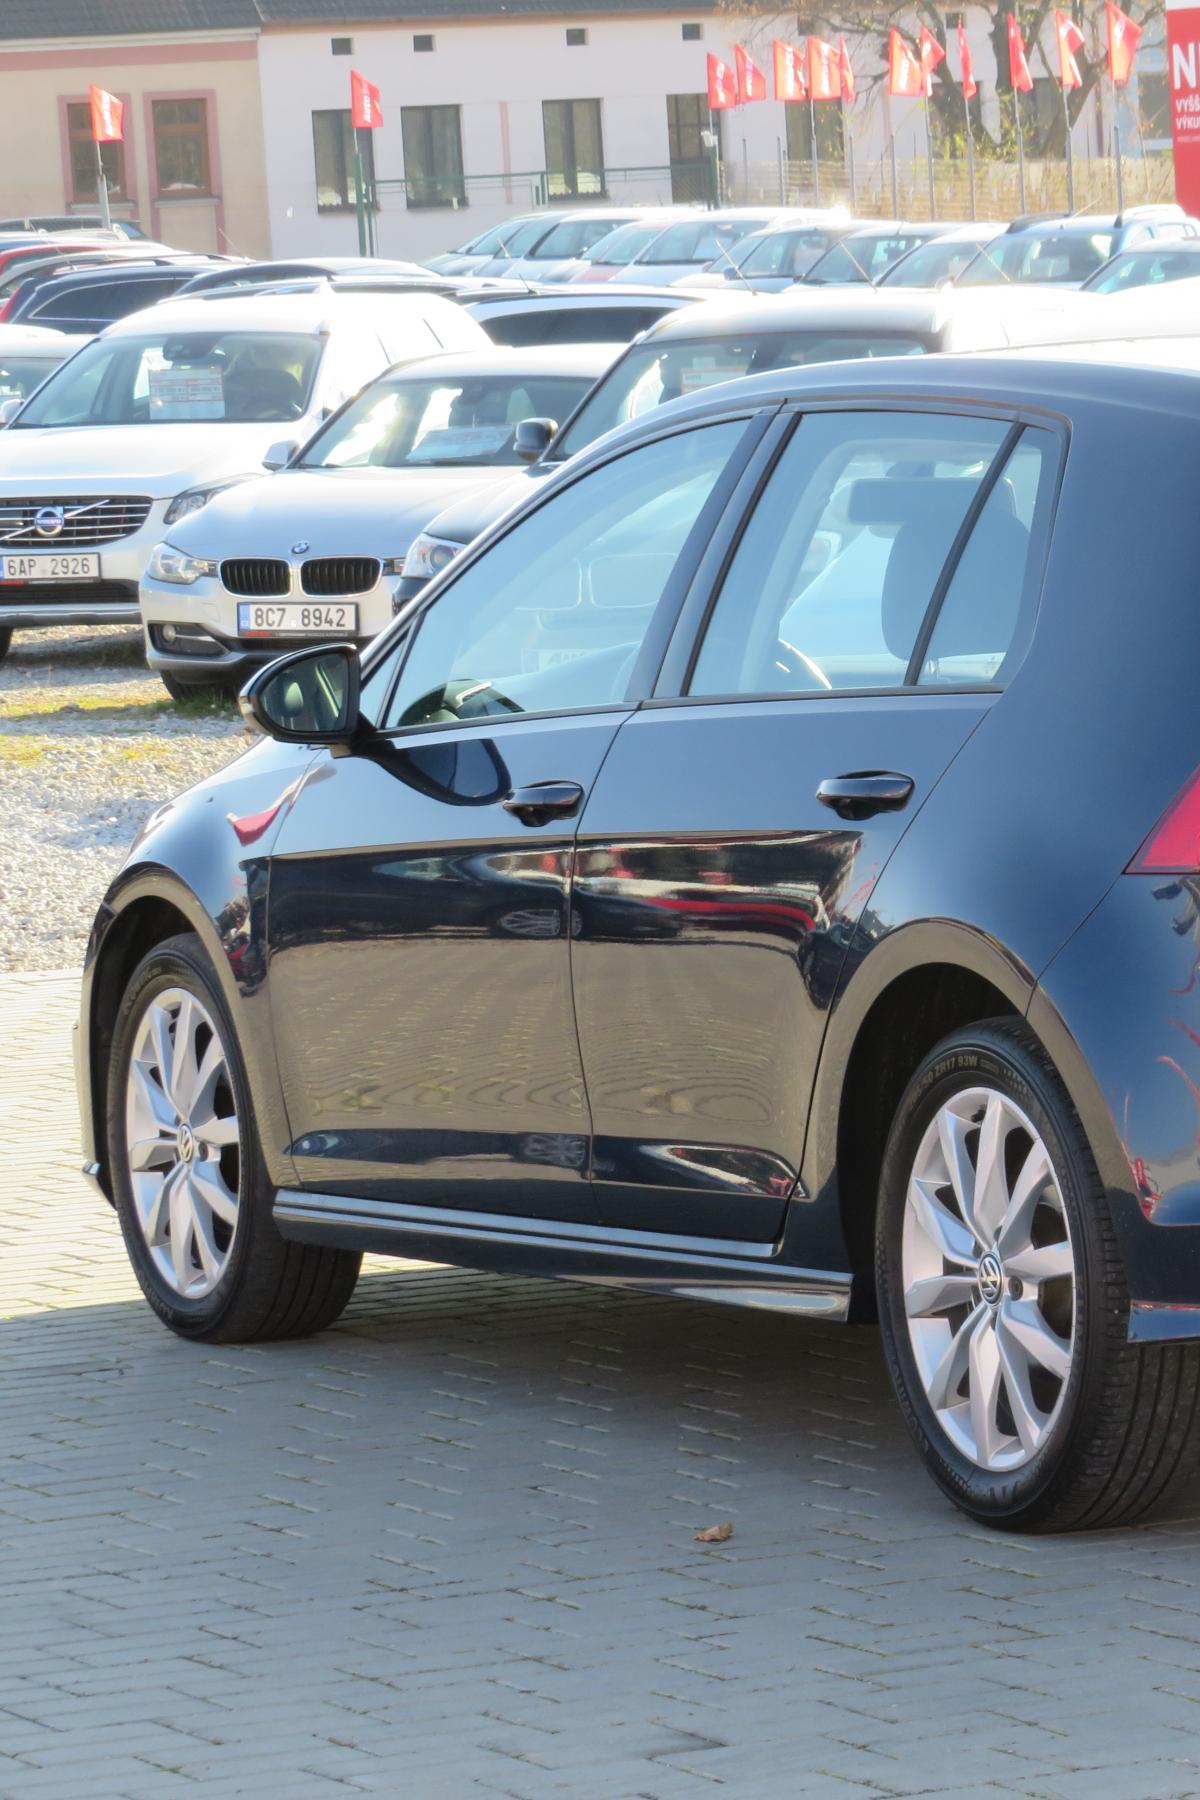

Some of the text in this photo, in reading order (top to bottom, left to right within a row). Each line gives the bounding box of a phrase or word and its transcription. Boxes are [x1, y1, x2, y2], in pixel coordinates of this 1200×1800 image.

[7, 557, 91, 576] 6AP 2926
[254, 607, 346, 628] 8C7 8942
